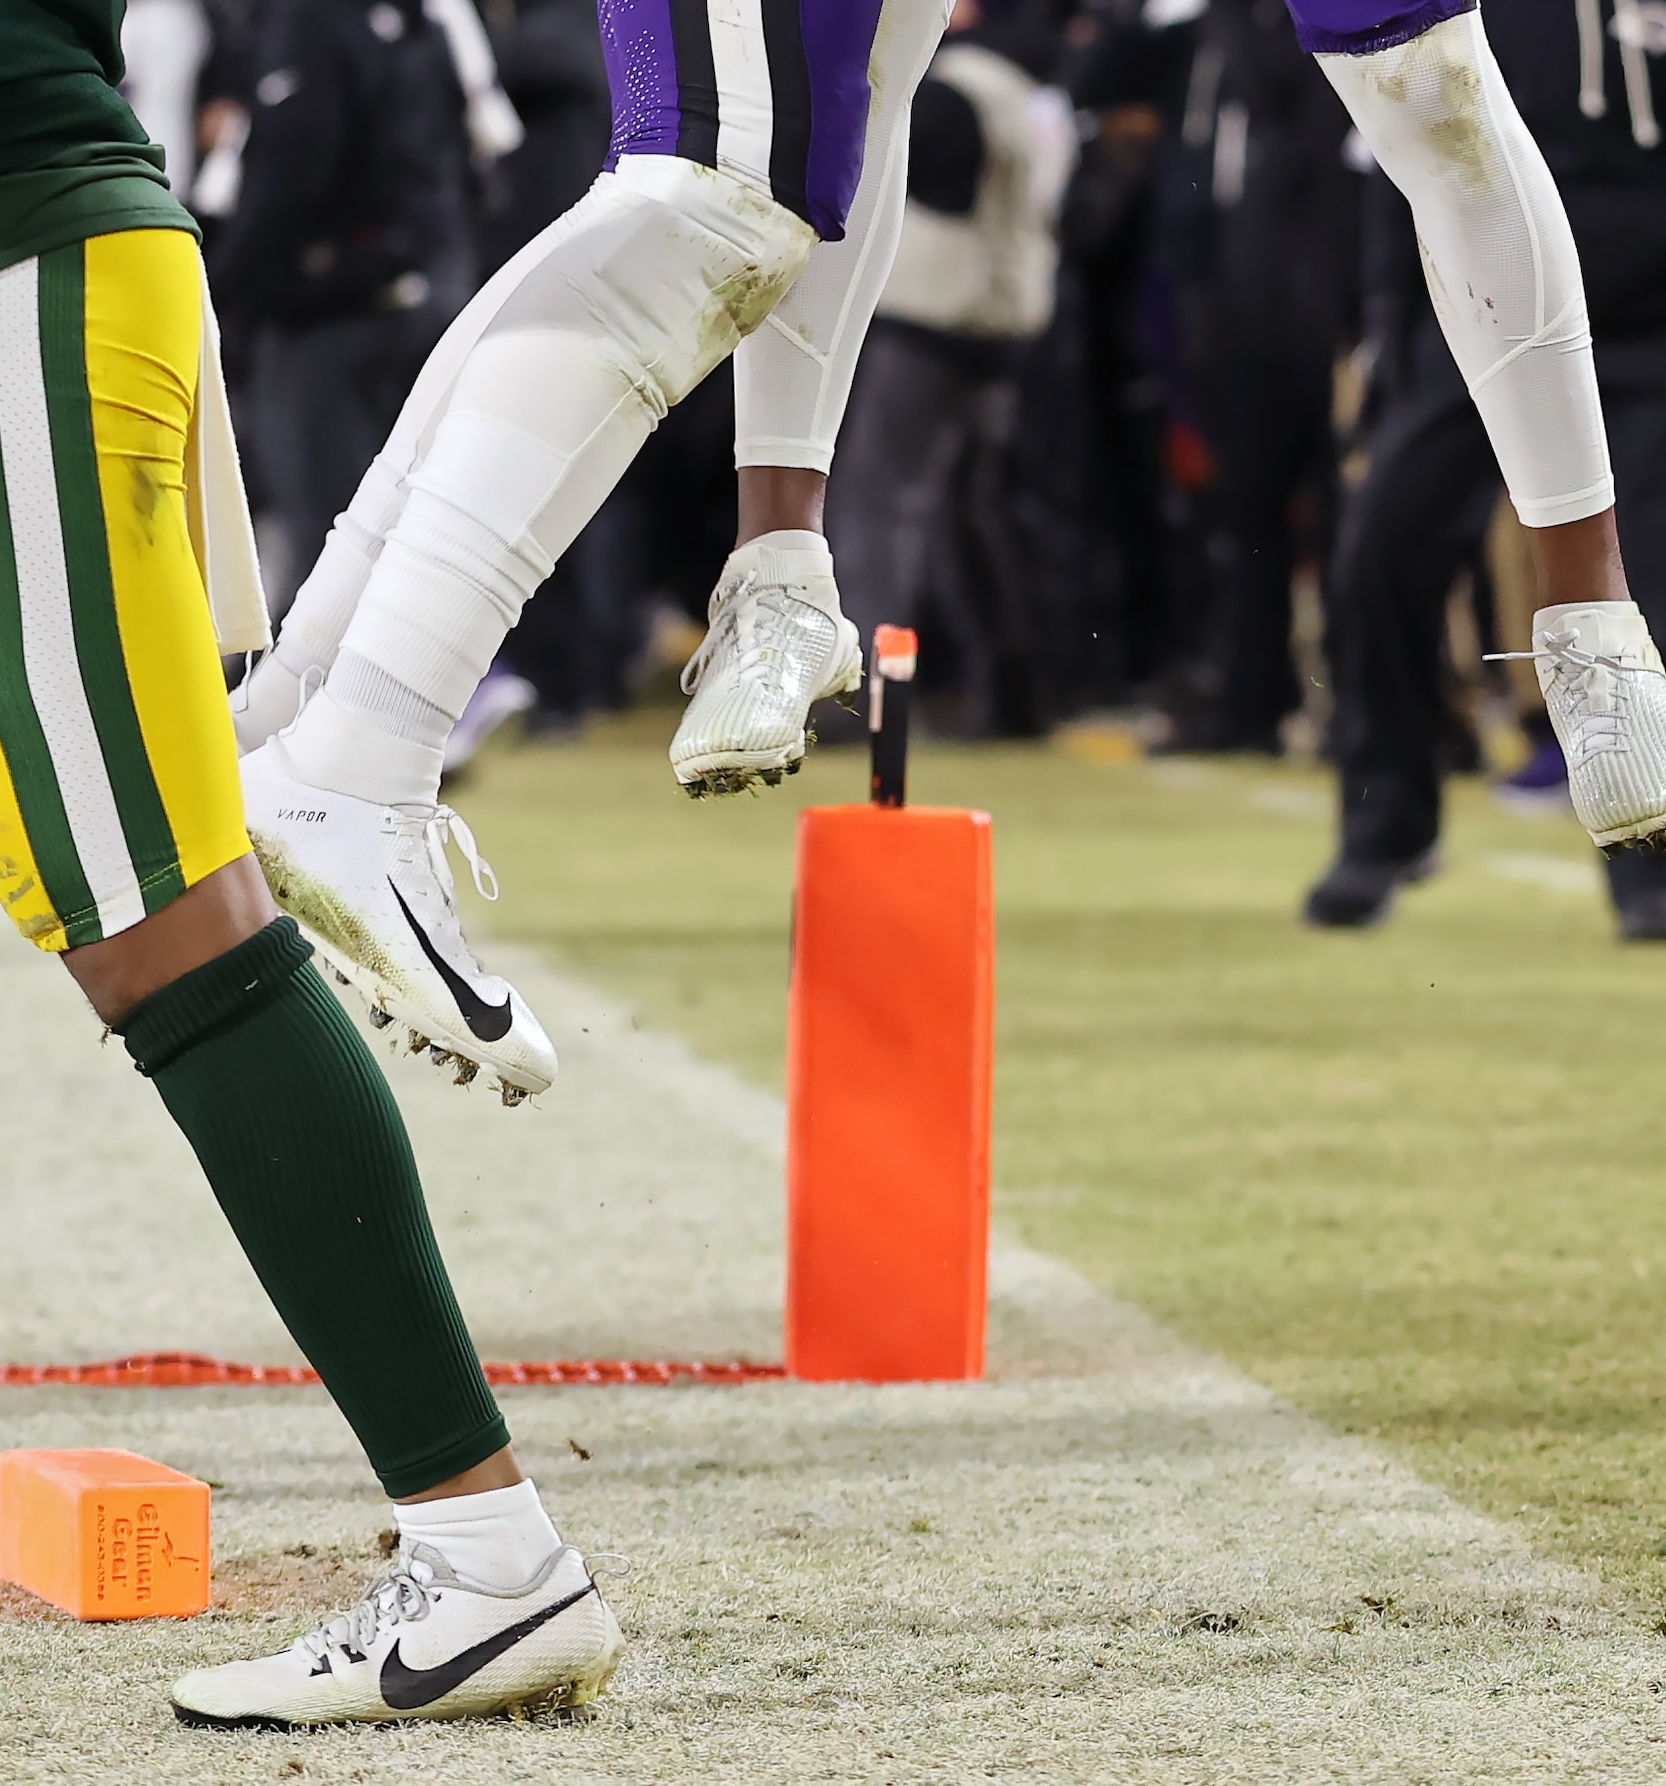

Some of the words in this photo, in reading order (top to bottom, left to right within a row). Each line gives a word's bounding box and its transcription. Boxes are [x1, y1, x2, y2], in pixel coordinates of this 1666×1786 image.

[278, 808, 327, 823] VAPOR
[112, 1517, 133, 1588] Gear
[136, 1503, 160, 1602] Gilman
